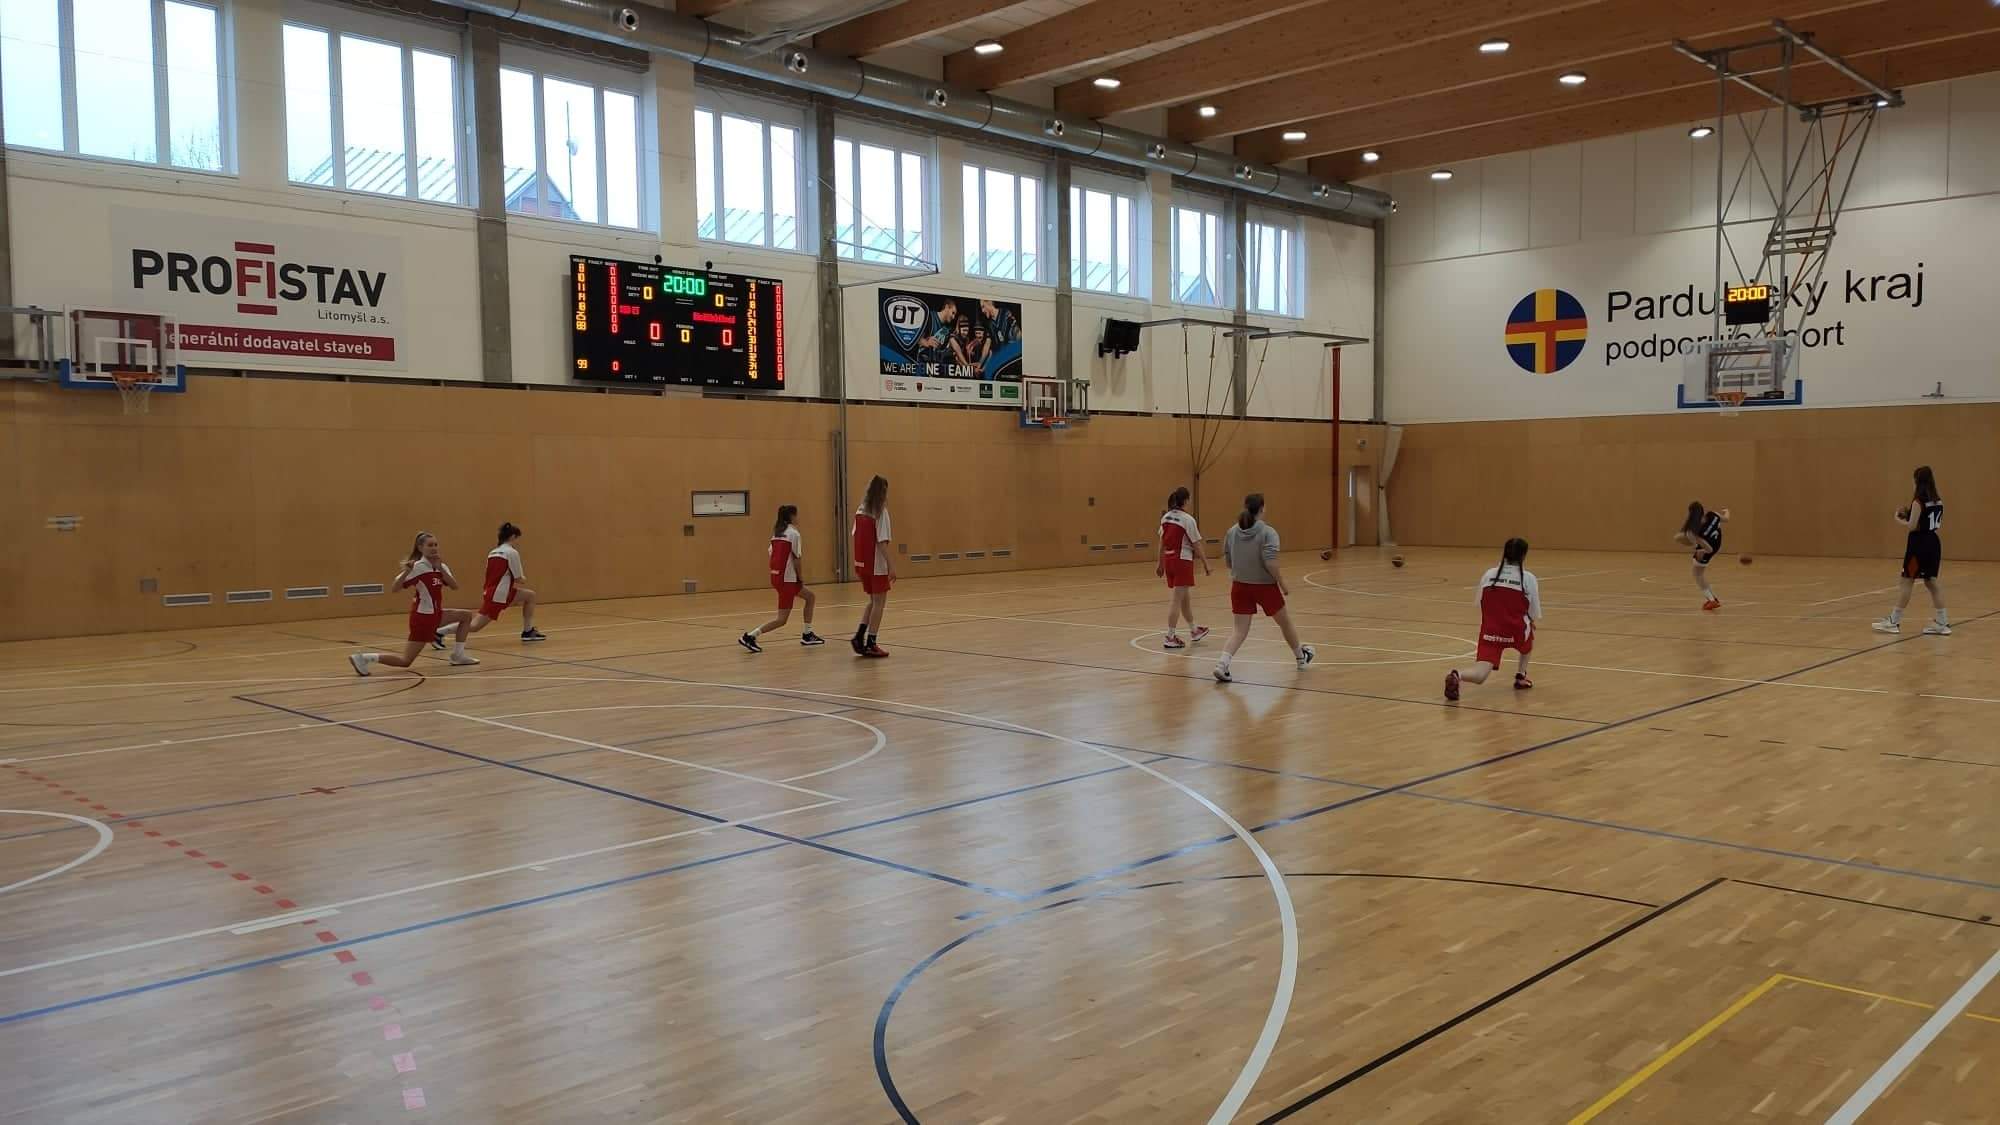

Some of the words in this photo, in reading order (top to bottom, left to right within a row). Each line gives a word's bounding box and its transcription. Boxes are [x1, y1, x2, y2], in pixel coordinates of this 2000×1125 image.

[132, 249, 386, 307] PROFISTAV
[663, 275, 705, 296] 20:00
[1845, 262, 1925, 307] kraj
[643, 286, 653, 300] 0
[715, 293, 724, 307] 0
[1728, 286, 1767, 302] 20:00
[318, 309, 366, 325] Litomyšl
[370, 313, 390, 325] a.s.
[650, 322, 660, 340] 0
[681, 329, 690, 343] 0
[722, 329, 732, 346] 0
[165, 331, 239, 348] enerální
[243, 335, 320, 352] dodavatel
[323, 340, 372, 355] staveb
[1606, 328, 1751, 365] podpor
[1766, 320, 1844, 354] ort
[577, 359, 588, 369] 99
[884, 362, 898, 374] WE
[900, 363, 916, 375] ARE
